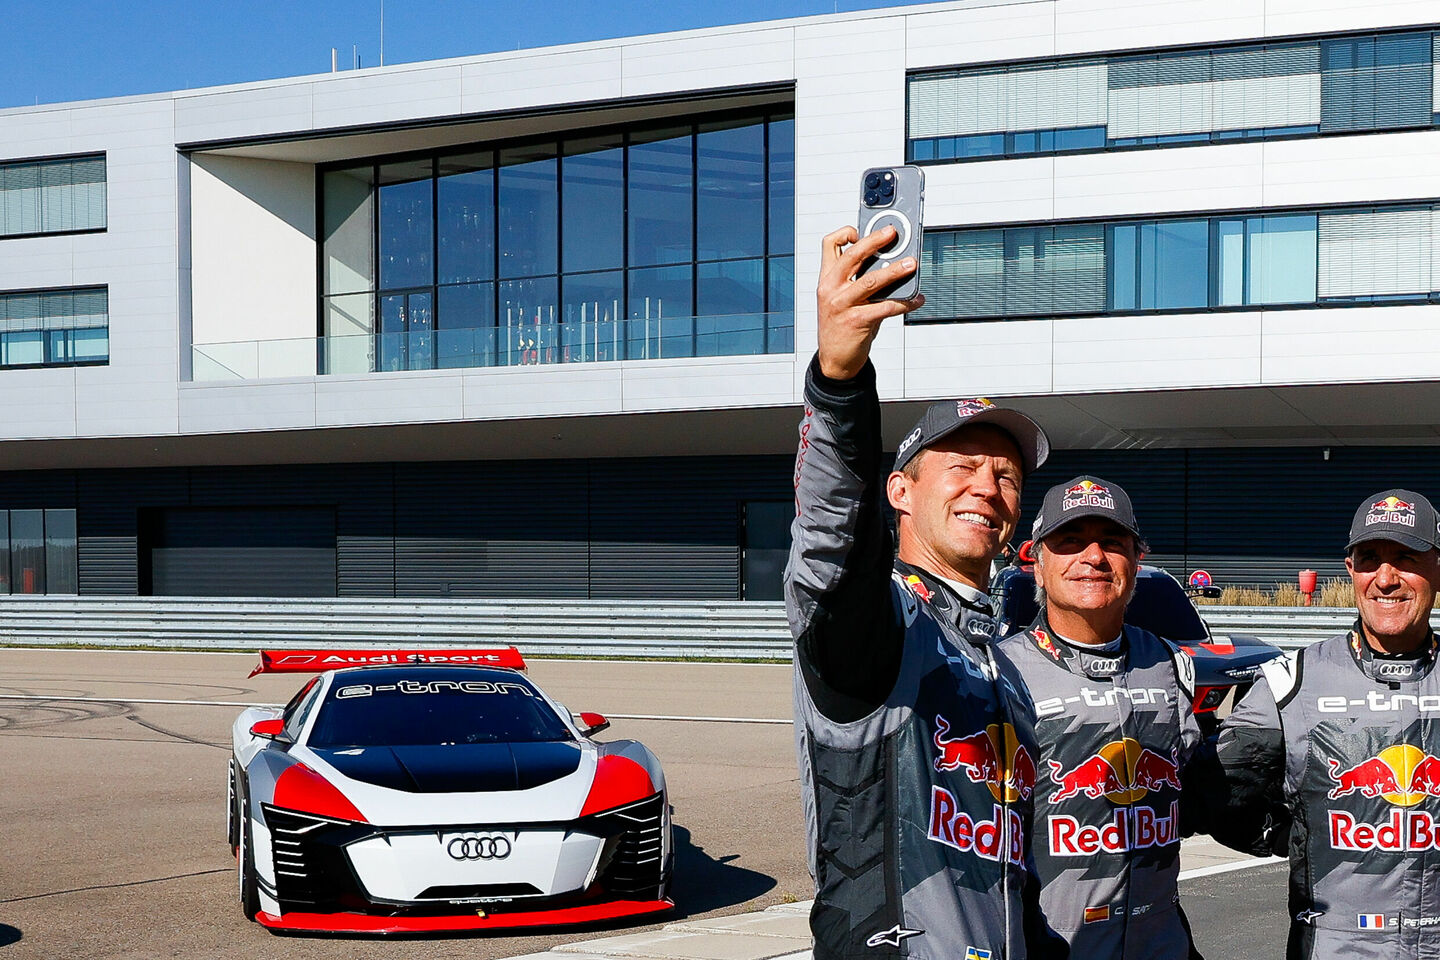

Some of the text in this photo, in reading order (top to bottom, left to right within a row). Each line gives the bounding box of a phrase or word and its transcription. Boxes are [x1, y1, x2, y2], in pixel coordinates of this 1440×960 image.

[957, 407, 984, 418] Re
[1063, 494, 1115, 511] Red Bull
[1365, 511, 1415, 528] Red Bull
[321, 653, 501, 664] Audi Sport
[336, 680, 534, 700] e-tron
[1034, 686, 1170, 717] e-tron
[927, 784, 1003, 862] Red
[1048, 807, 1129, 857] Red
[1132, 800, 1180, 849] Bull
[1327, 807, 1405, 852] Red
